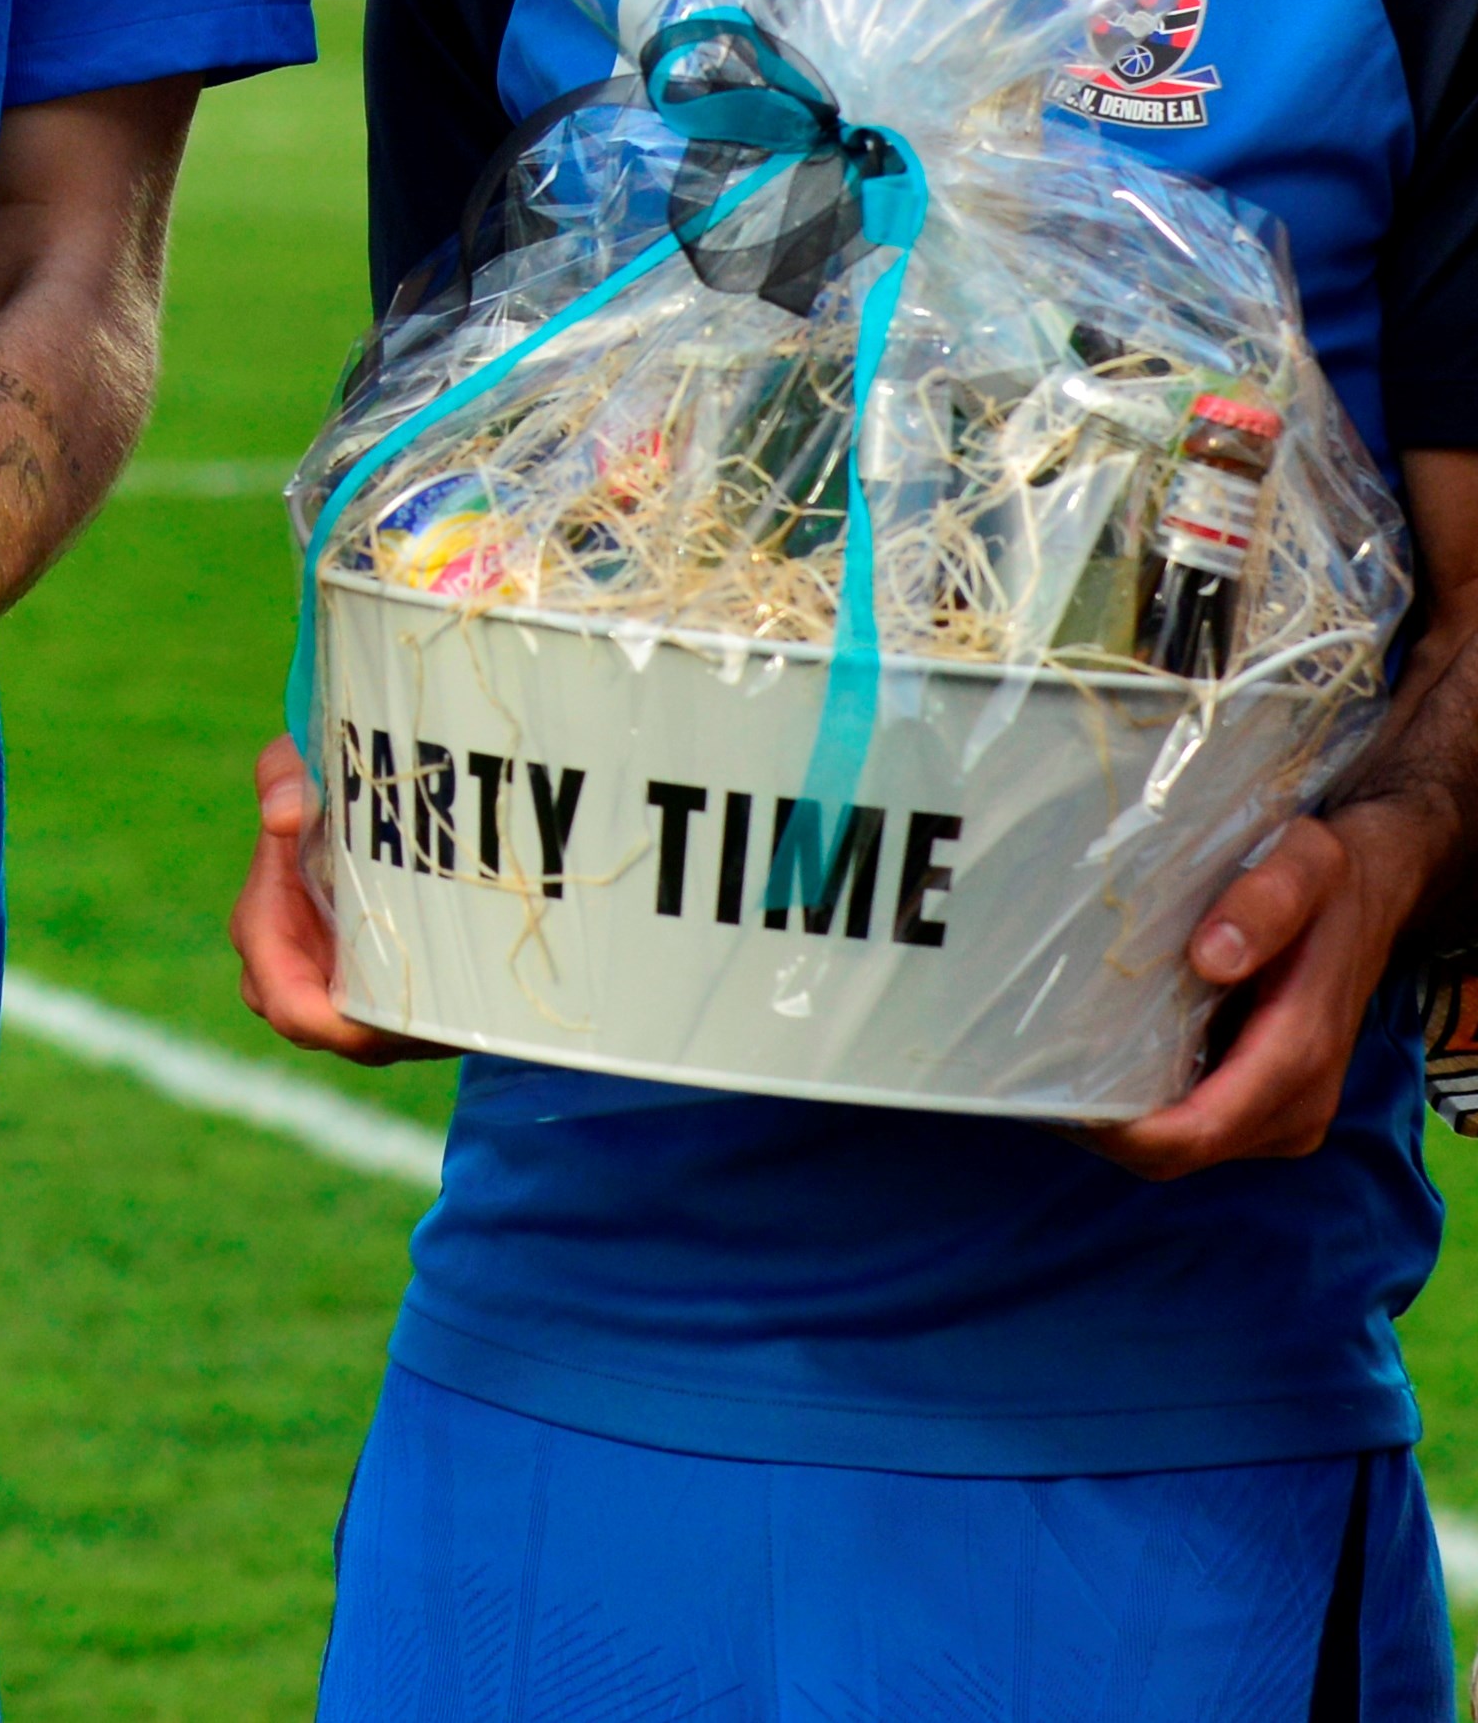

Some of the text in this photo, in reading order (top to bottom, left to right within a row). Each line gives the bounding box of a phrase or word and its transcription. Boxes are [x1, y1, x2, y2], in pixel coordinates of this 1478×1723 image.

[1098, 92, 1165, 123] DENDER
[1166, 99, 1201, 123] E.H.
[340, 719, 964, 948] PARTY TIME
